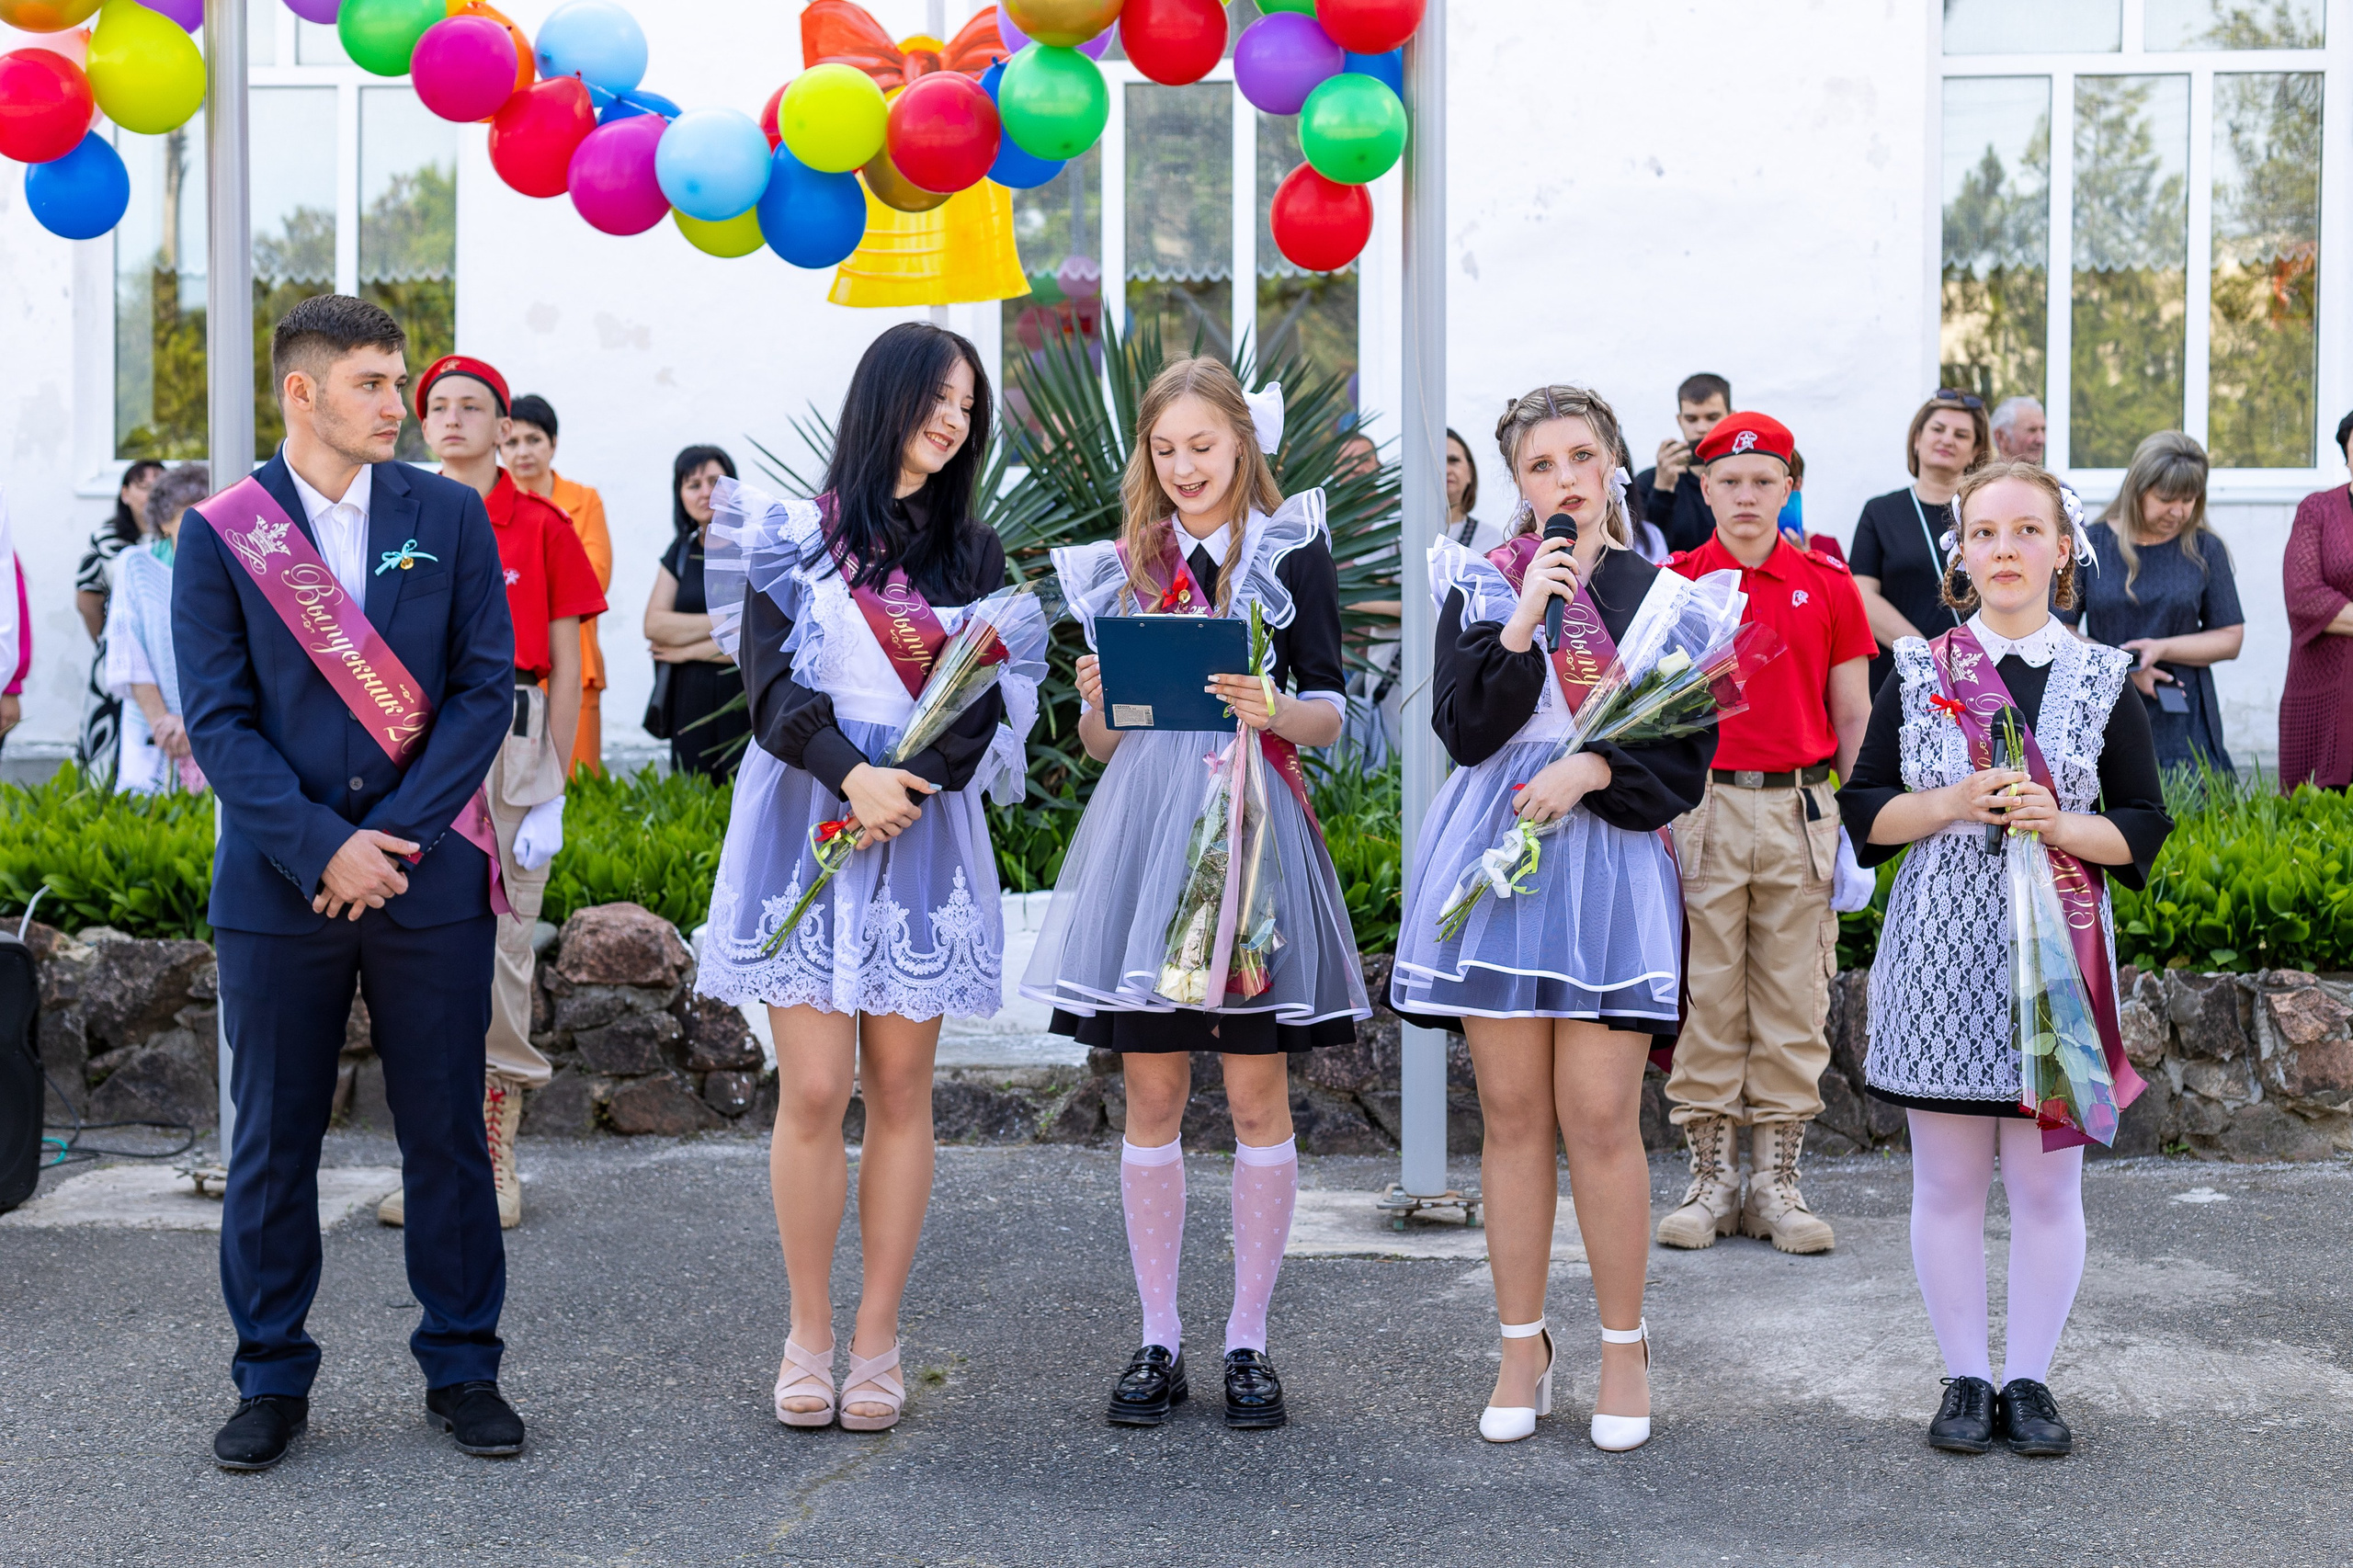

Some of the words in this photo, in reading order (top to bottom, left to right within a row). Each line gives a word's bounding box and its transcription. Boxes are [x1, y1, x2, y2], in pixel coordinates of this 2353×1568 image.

[280, 562, 404, 716] Выпускник
[383, 710, 432, 755] 20
[876, 582, 934, 676] Выпус
